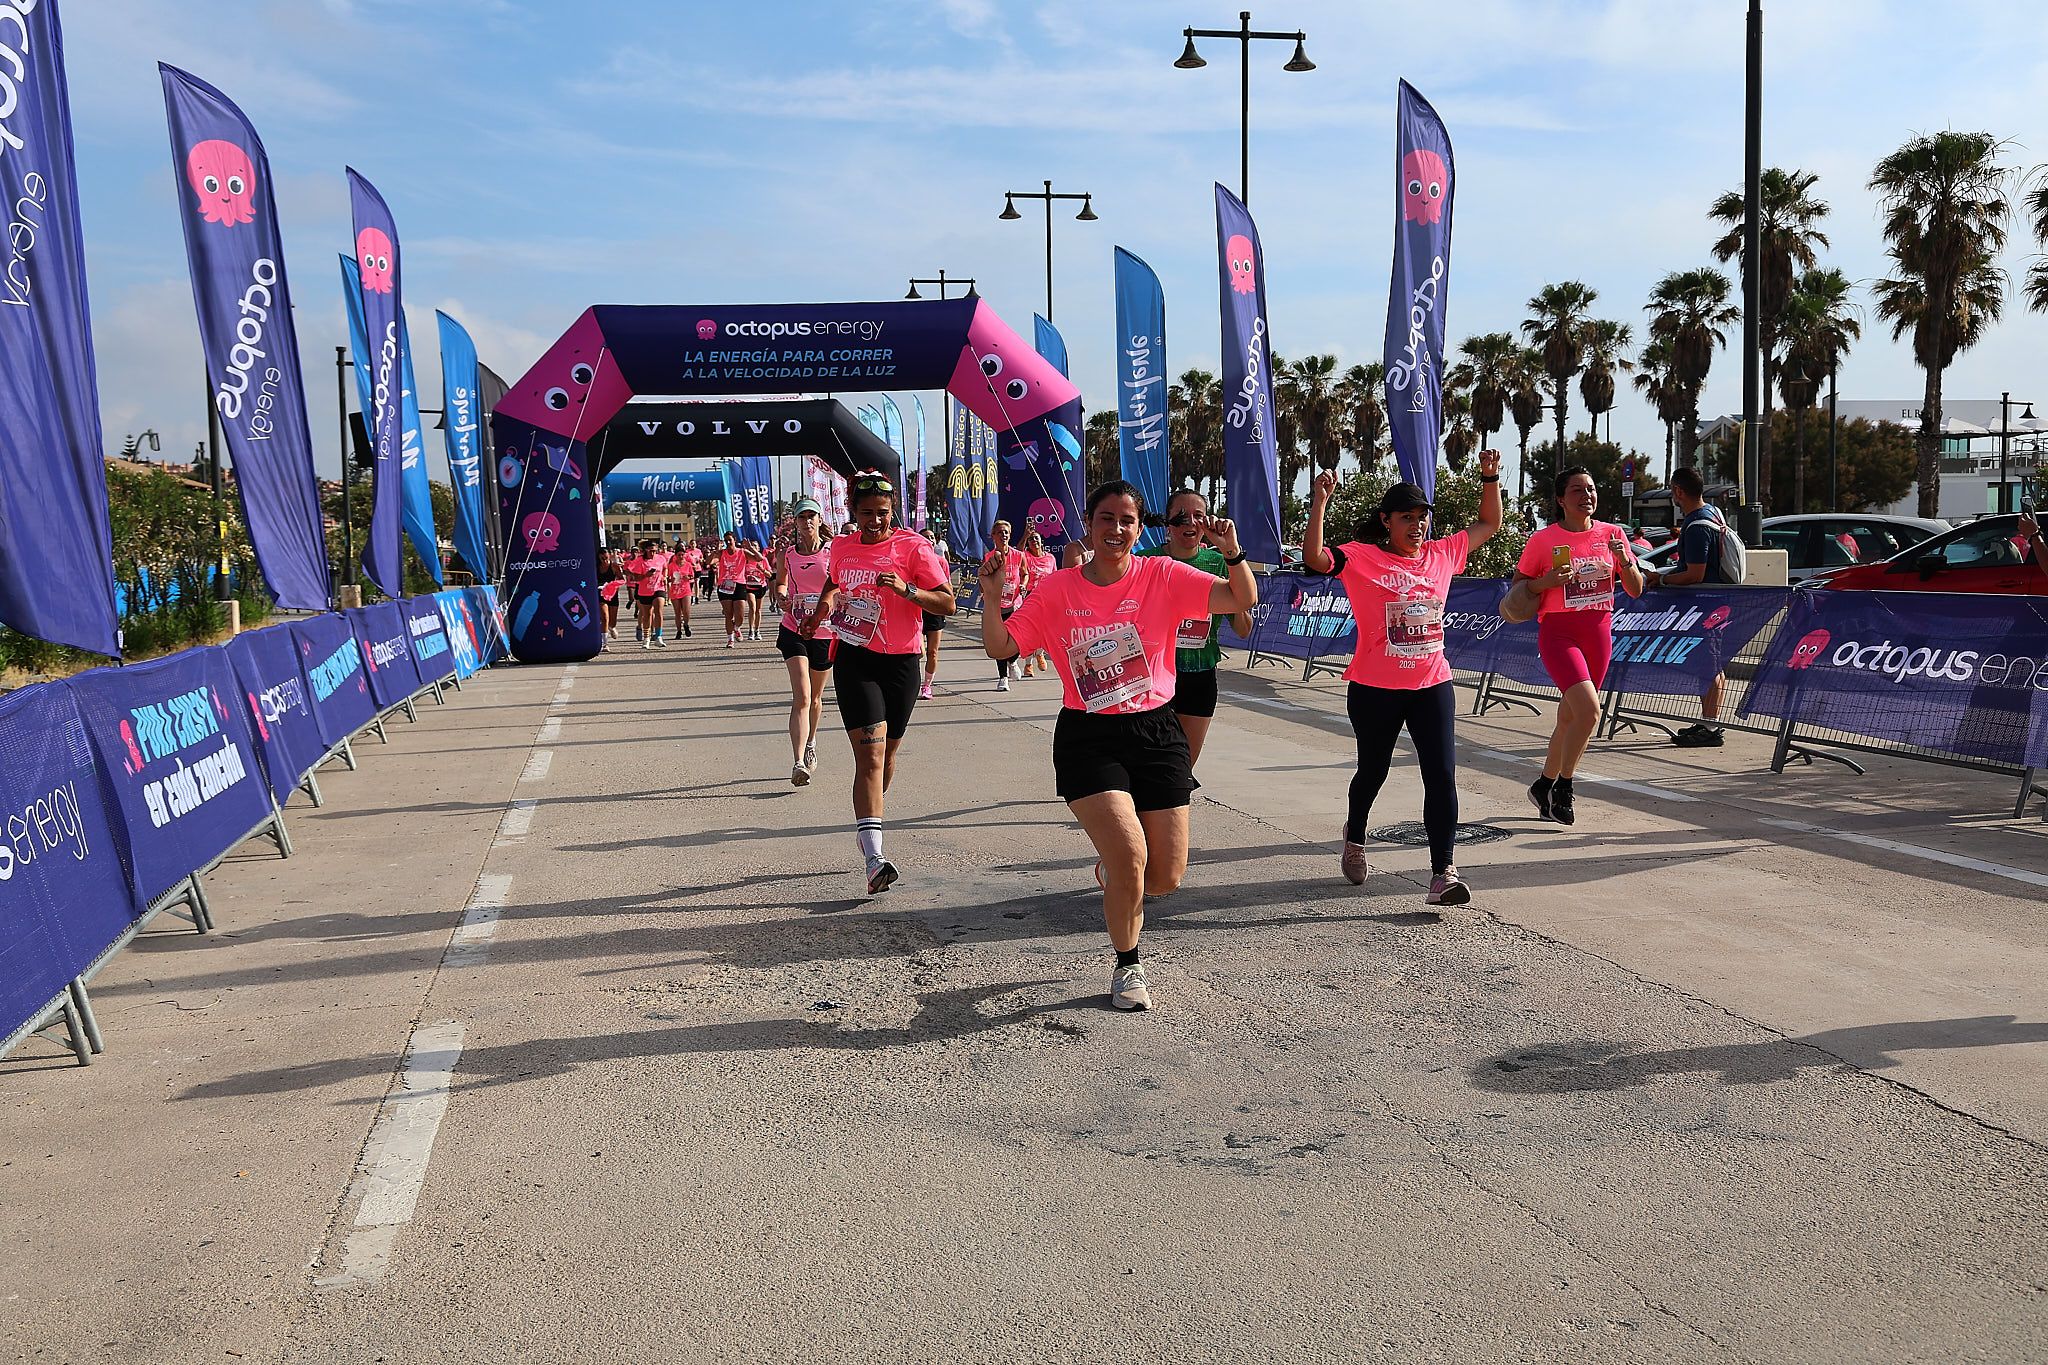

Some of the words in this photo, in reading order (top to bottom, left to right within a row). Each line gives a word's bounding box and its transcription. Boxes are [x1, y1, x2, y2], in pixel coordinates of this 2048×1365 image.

[725, 320, 811, 340] octopus
[813, 320, 884, 340] energy
[684, 351, 704, 363] LA
[709, 348, 778, 363] ENERGÍA
[782, 350, 825, 362] PARA
[829, 349, 893, 361] CORRER
[682, 368, 694, 379] A
[698, 368, 718, 378] LA
[723, 367, 814, 378] VELOCIDAD
[817, 366, 838, 377] DE
[841, 366, 862, 377] LA
[866, 365, 896, 376] LUZ
[637, 419, 802, 436] VOLVO
[642, 474, 695, 498] Marlene
[510, 558, 547, 572] octopus
[547, 557, 582, 570] energy
[838, 569, 881, 585] CARRER
[1580, 580, 1597, 590] 016
[844, 614, 861, 627] 016
[1065, 608, 1092, 617] OYSHO
[1180, 619, 1193, 629] 16
[1407, 624, 1428, 635] 016
[1452, 612, 1506, 640] energy
[1628, 636, 1664, 662] LA
[1653, 636, 1704, 664] LUZ
[1097, 662, 1124, 681] 016
[1832, 640, 1979, 684] octopus
[1980, 653, 2048, 691] ene
[8, 780, 89, 861] energy
